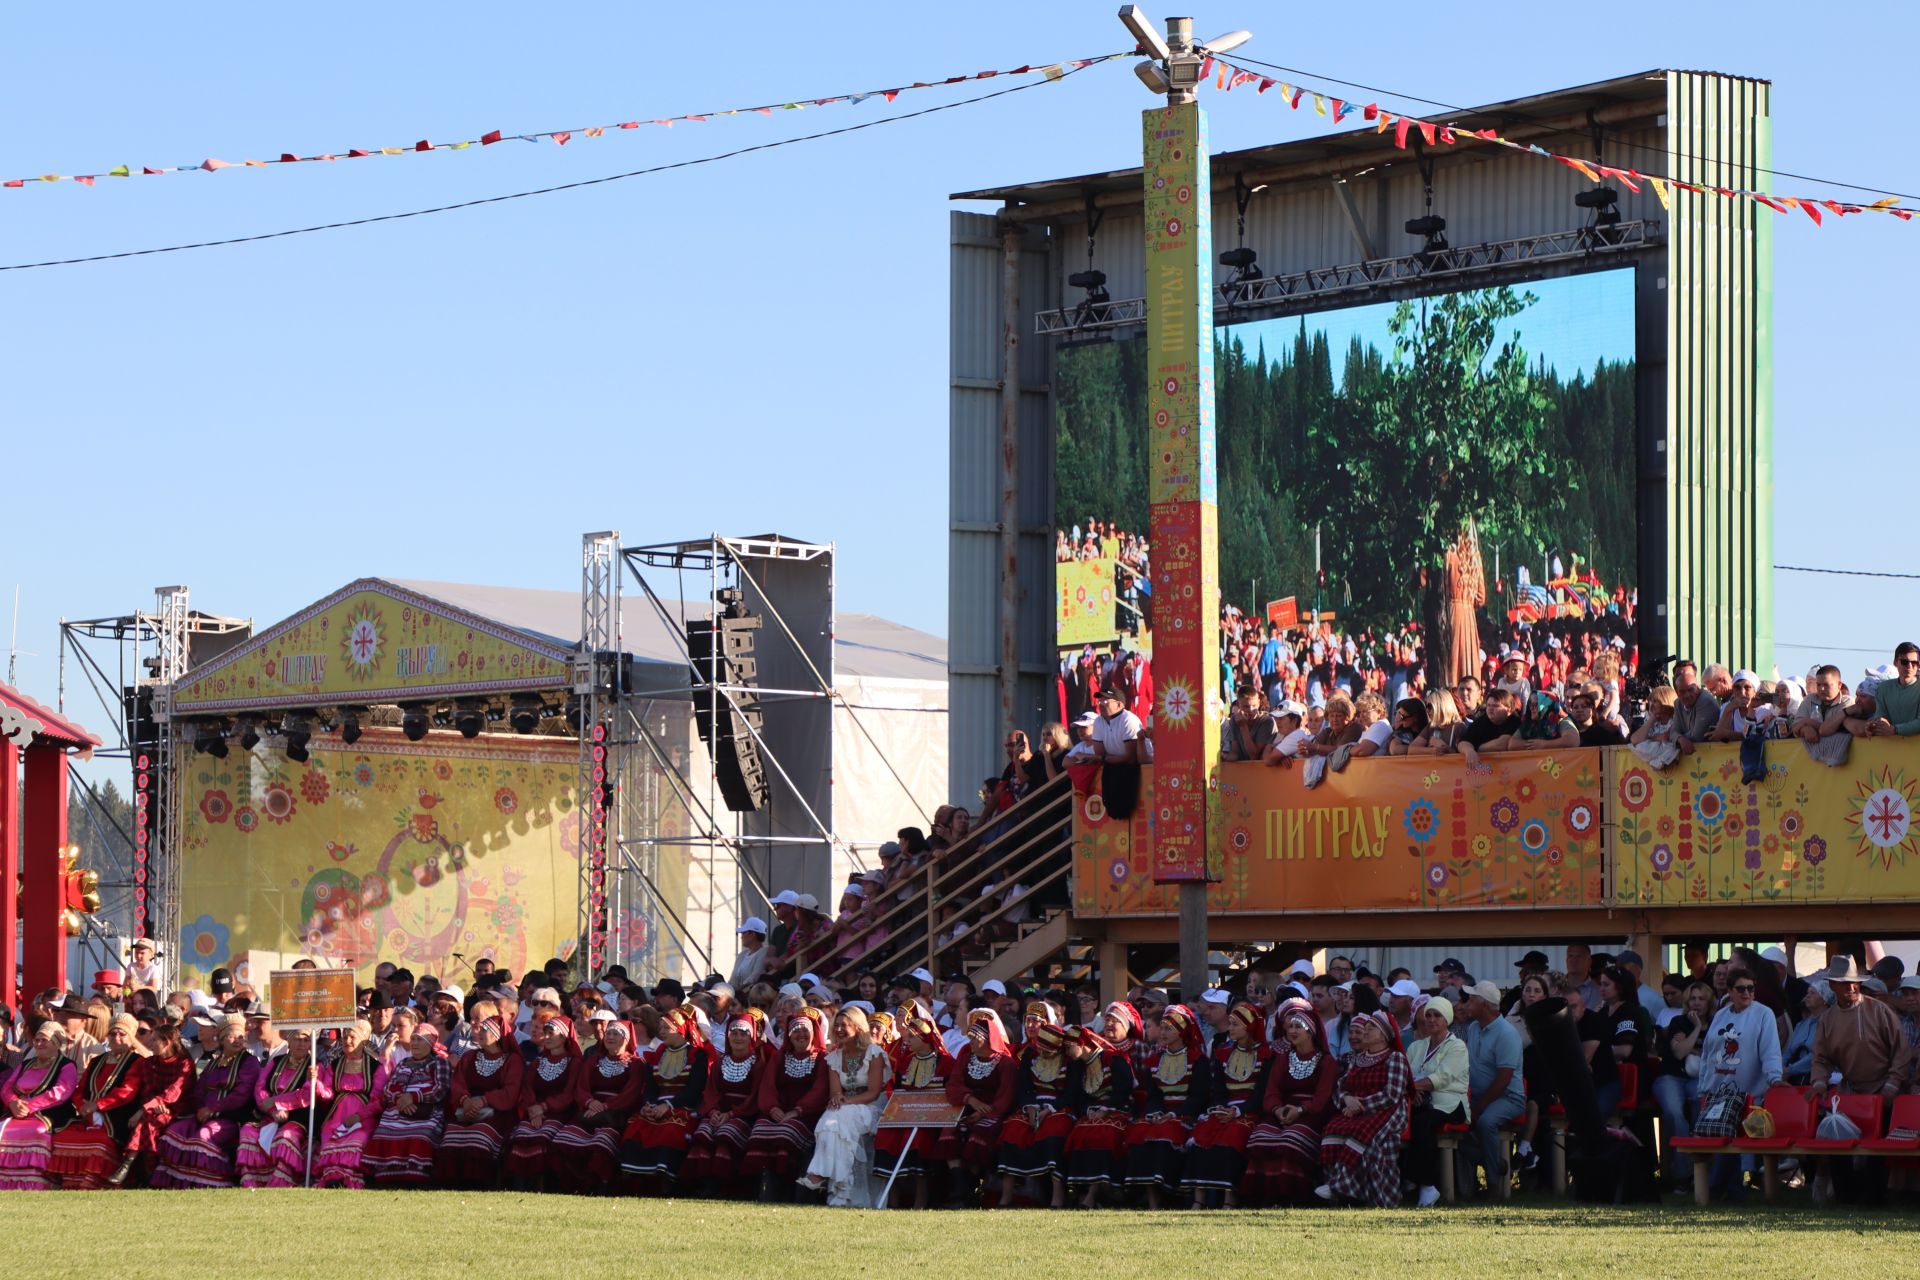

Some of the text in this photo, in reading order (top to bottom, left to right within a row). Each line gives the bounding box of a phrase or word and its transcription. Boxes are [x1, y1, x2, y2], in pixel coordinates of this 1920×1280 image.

[1161, 264, 1184, 352] ПИТРАУ
[282, 654, 327, 684] ПИТРАУ
[1265, 806, 1392, 860] ПИТРАУ
